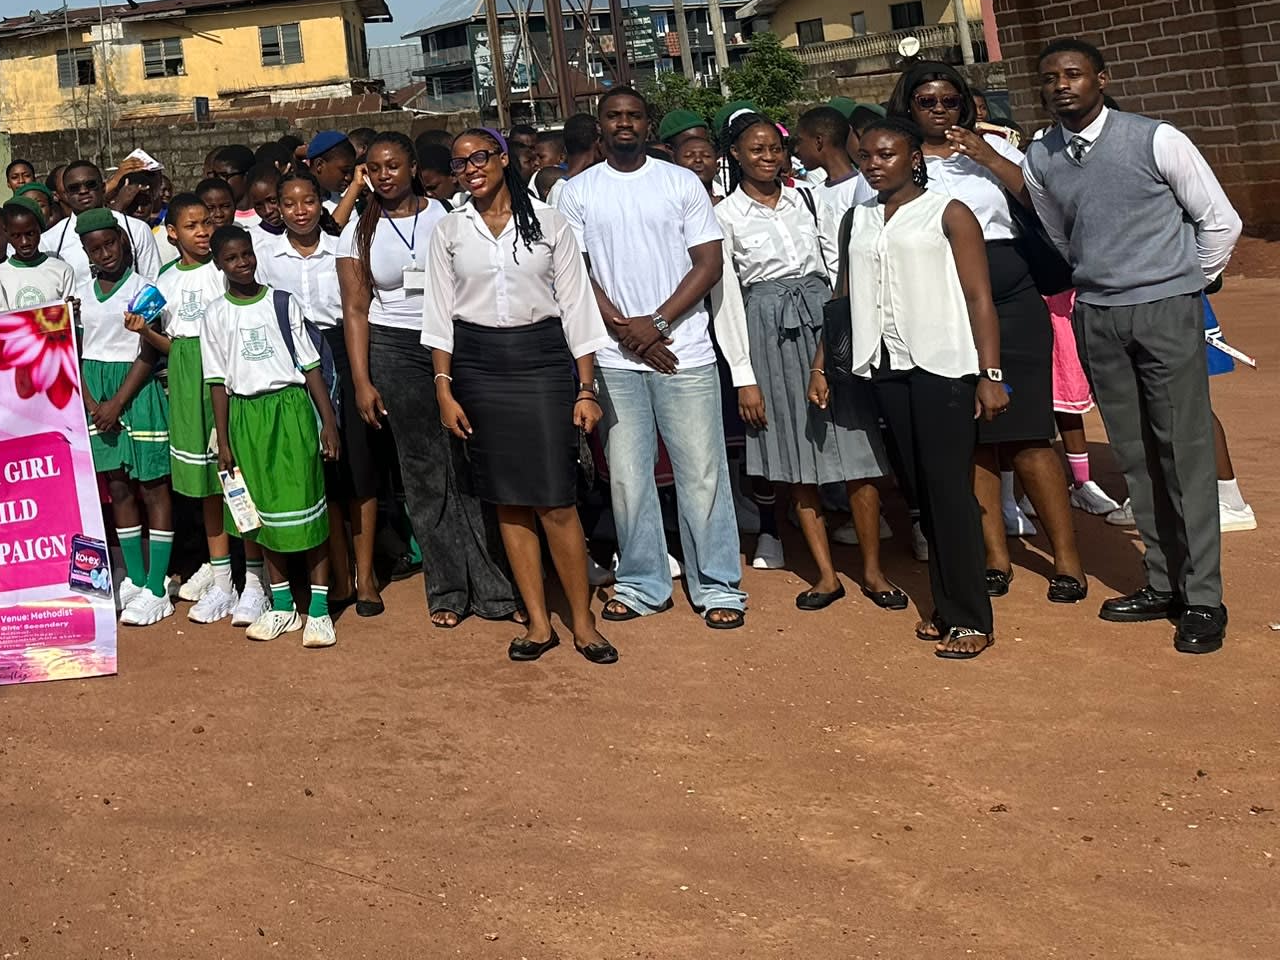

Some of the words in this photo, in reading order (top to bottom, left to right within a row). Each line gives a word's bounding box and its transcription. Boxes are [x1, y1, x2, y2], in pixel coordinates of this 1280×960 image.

[4, 455, 61, 483] GIRL
[0, 614, 29, 623] Venue:
[31, 608, 73, 621] Methodist
[23, 621, 69, 630] Secondary
